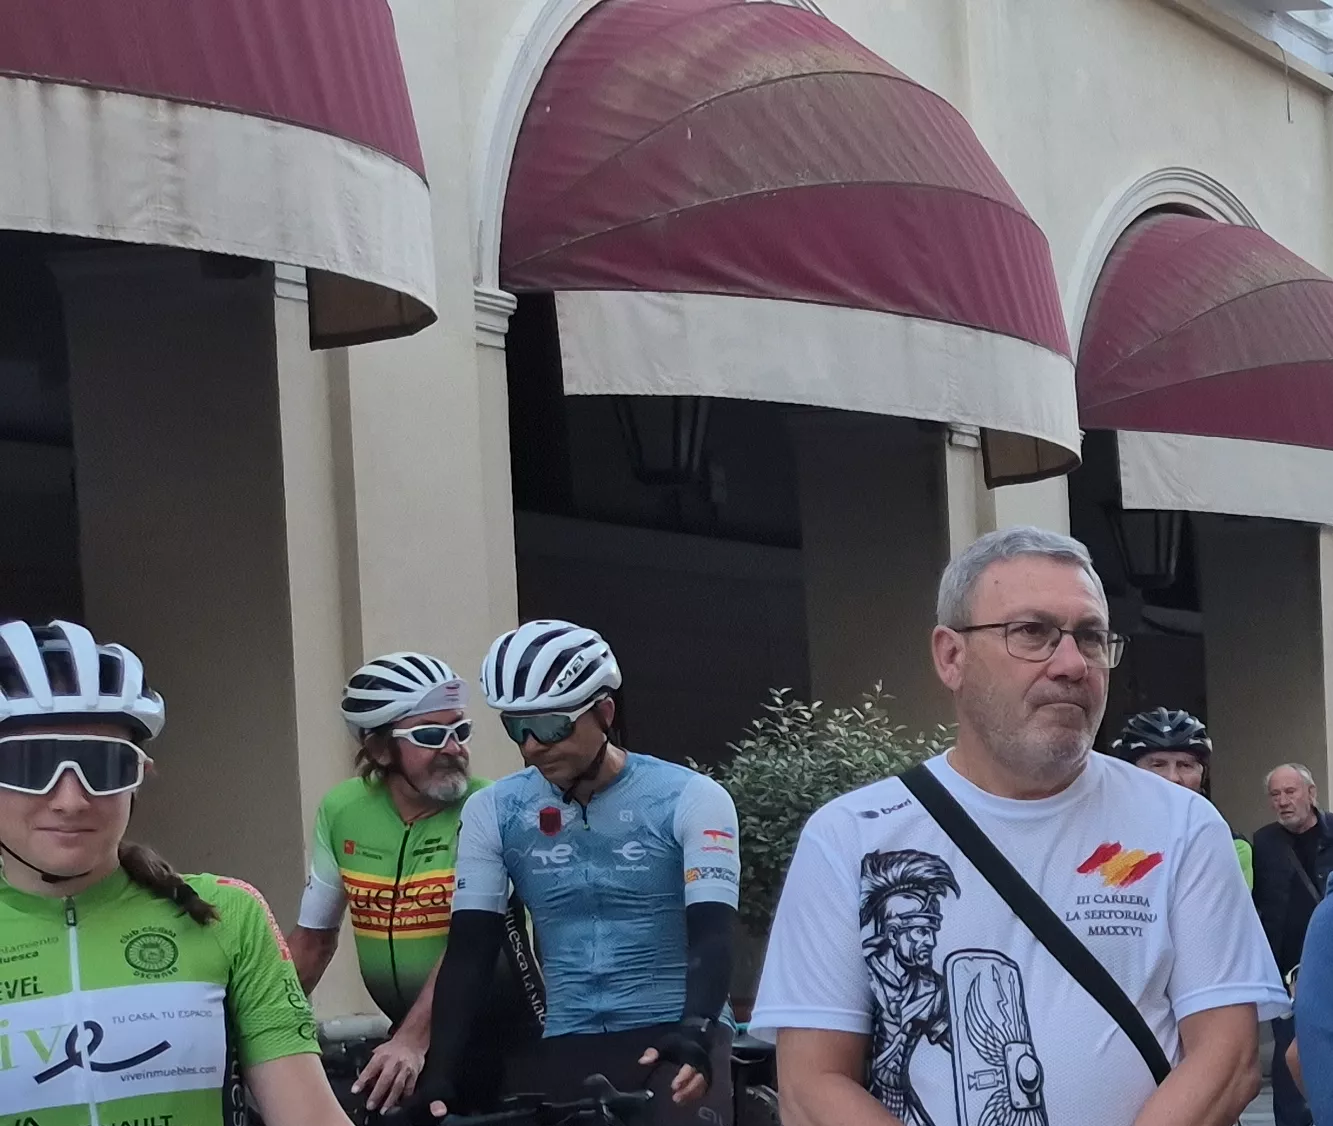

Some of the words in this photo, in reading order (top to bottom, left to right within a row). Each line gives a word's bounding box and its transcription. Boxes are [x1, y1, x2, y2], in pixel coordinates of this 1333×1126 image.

[556, 654, 585, 689] MET
[1076, 895, 1091, 907] III
[1093, 894, 1150, 908] CARRERA
[1065, 910, 1082, 922] LA
[119, 928, 140, 945] club
[1087, 925, 1144, 938] MMXXVI
[132, 967, 180, 980] oscense
[160, 1011, 175, 1020] TU
